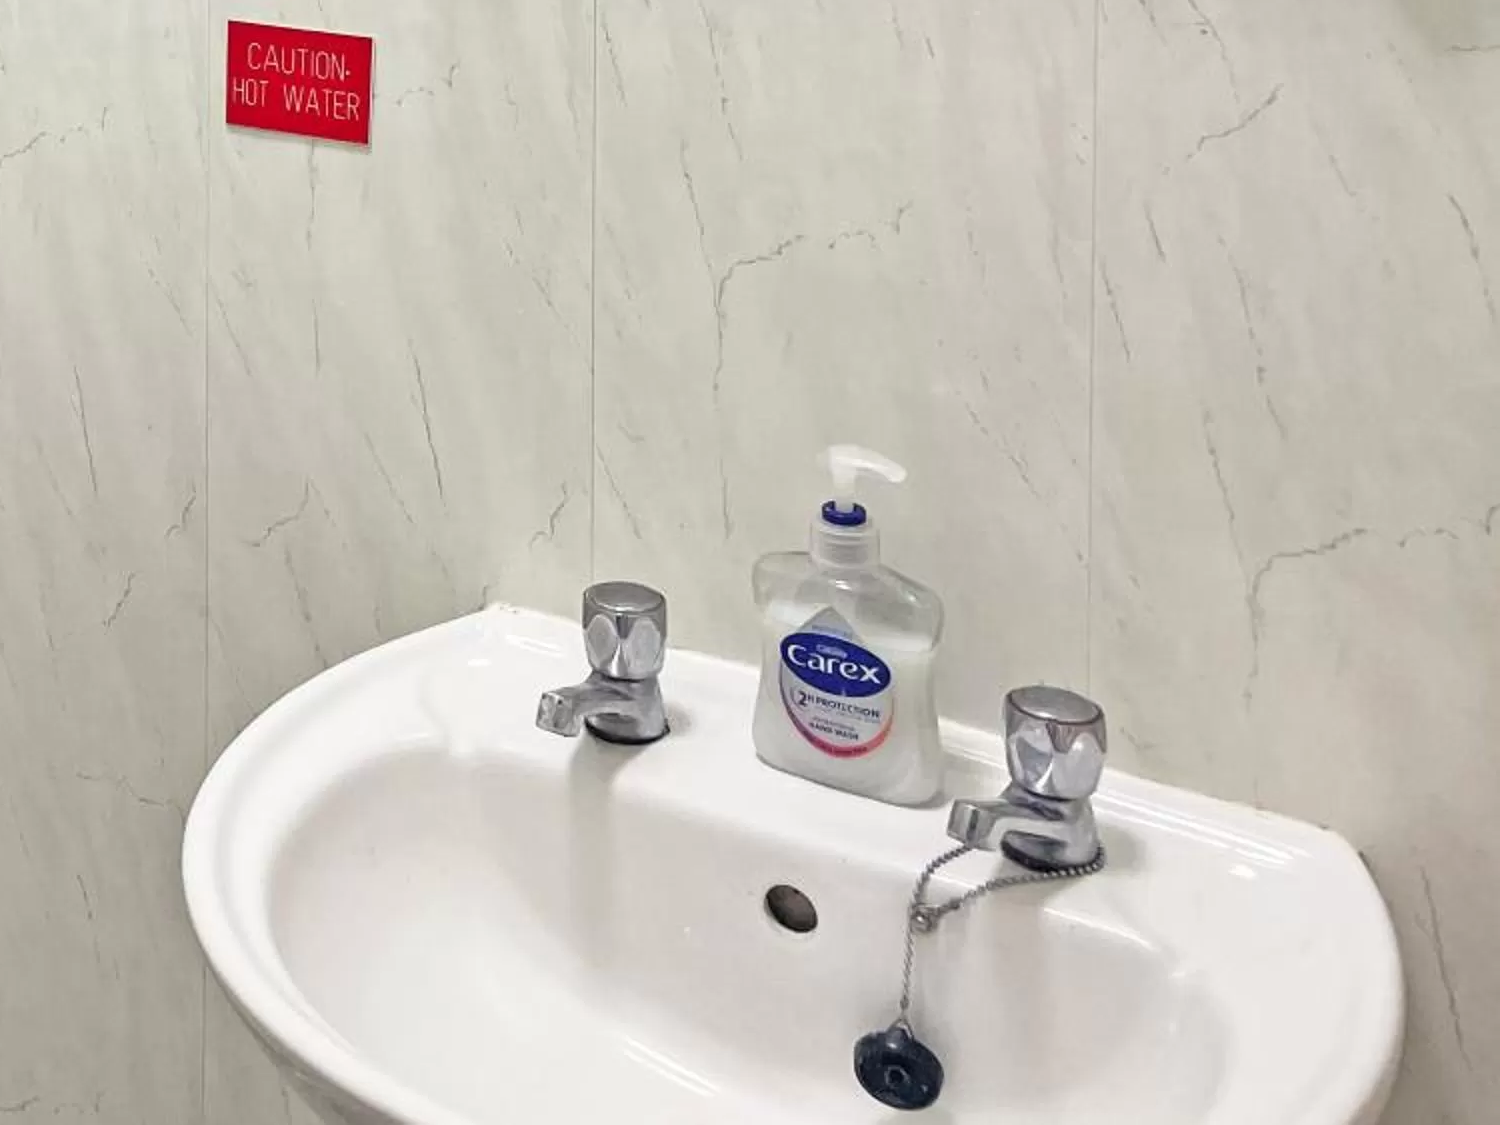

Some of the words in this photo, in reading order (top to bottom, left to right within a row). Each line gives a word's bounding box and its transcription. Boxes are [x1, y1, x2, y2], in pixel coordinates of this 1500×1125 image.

[233, 78, 269, 106] HOT
[283, 85, 360, 120] WATER
[787, 644, 880, 684] Carex
[816, 695, 880, 718] PROTECTION
